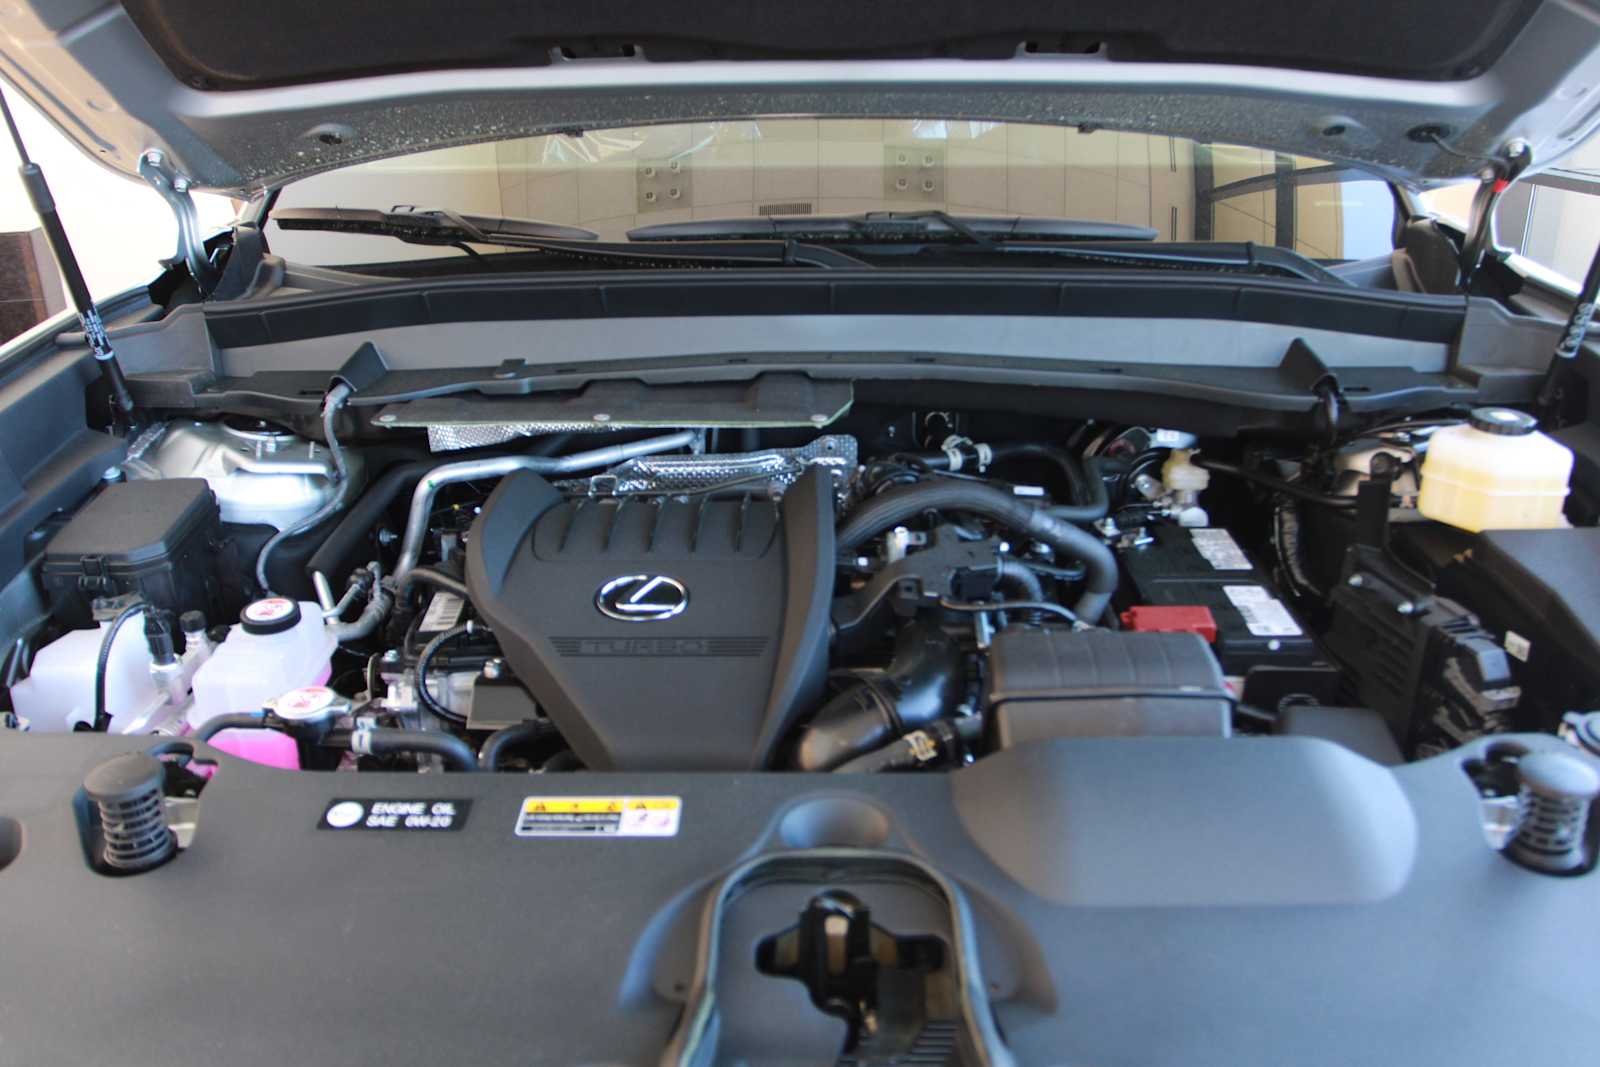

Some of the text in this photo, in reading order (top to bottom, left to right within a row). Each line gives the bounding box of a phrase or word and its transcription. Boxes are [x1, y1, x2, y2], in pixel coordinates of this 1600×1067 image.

[580, 639, 705, 654] TURBO
[371, 801, 427, 815] ENGINE
[431, 802, 456, 816] OIL
[366, 814, 399, 828] SAE
